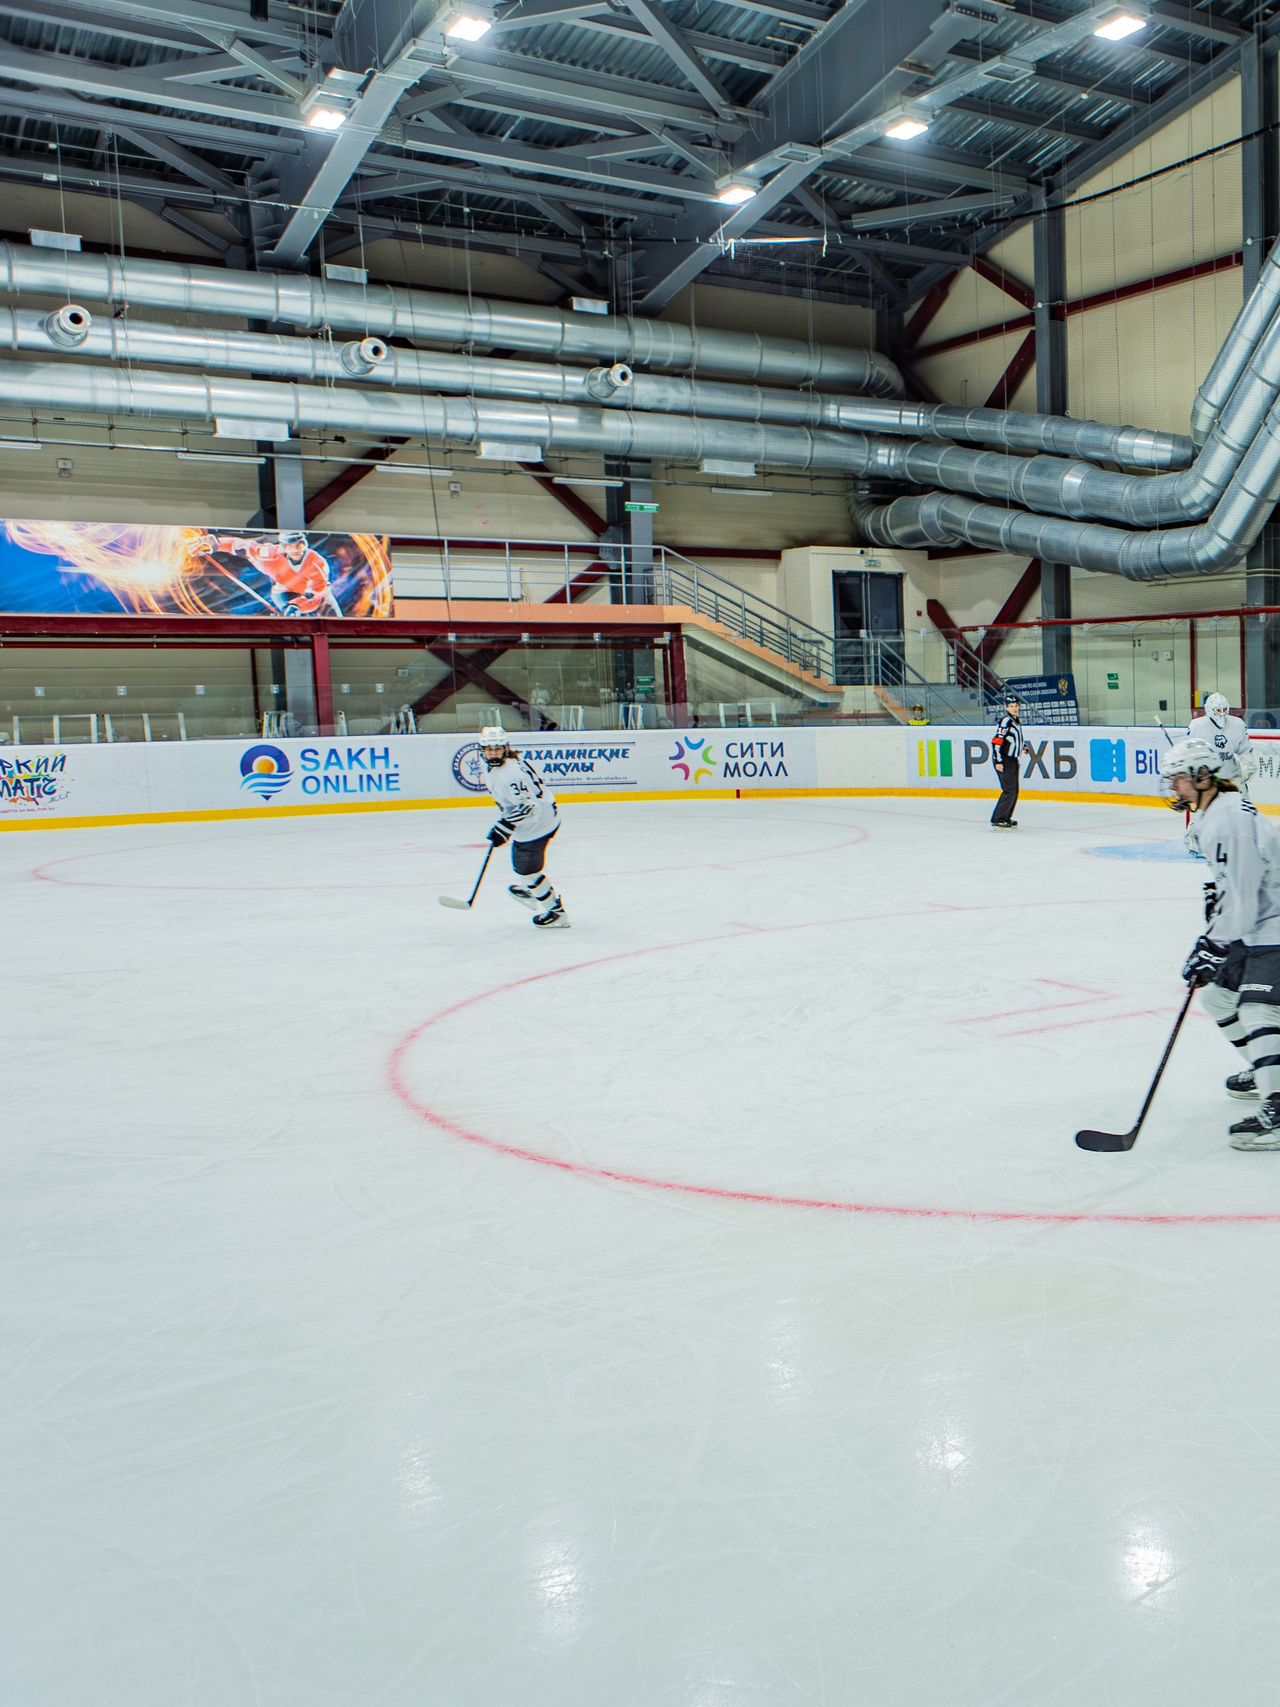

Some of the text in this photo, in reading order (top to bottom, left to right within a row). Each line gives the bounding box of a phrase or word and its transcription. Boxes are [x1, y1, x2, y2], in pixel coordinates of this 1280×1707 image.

[300, 747, 399, 772] SAKH.
[519, 748, 630, 763] АХАЛИНСКИЕ
[725, 742, 785, 758] СИТИ
[965, 740, 1077, 780] РХБ
[0, 753, 67, 775] РКИЙ
[543, 762, 595, 776] АКУЛЫ
[723, 761, 789, 778] МОЛЛ
[1135, 749, 1161, 775] Bil
[301, 773, 400, 795] ONLINE
[510, 781, 530, 796] 34
[1216, 843, 1228, 866] 4
